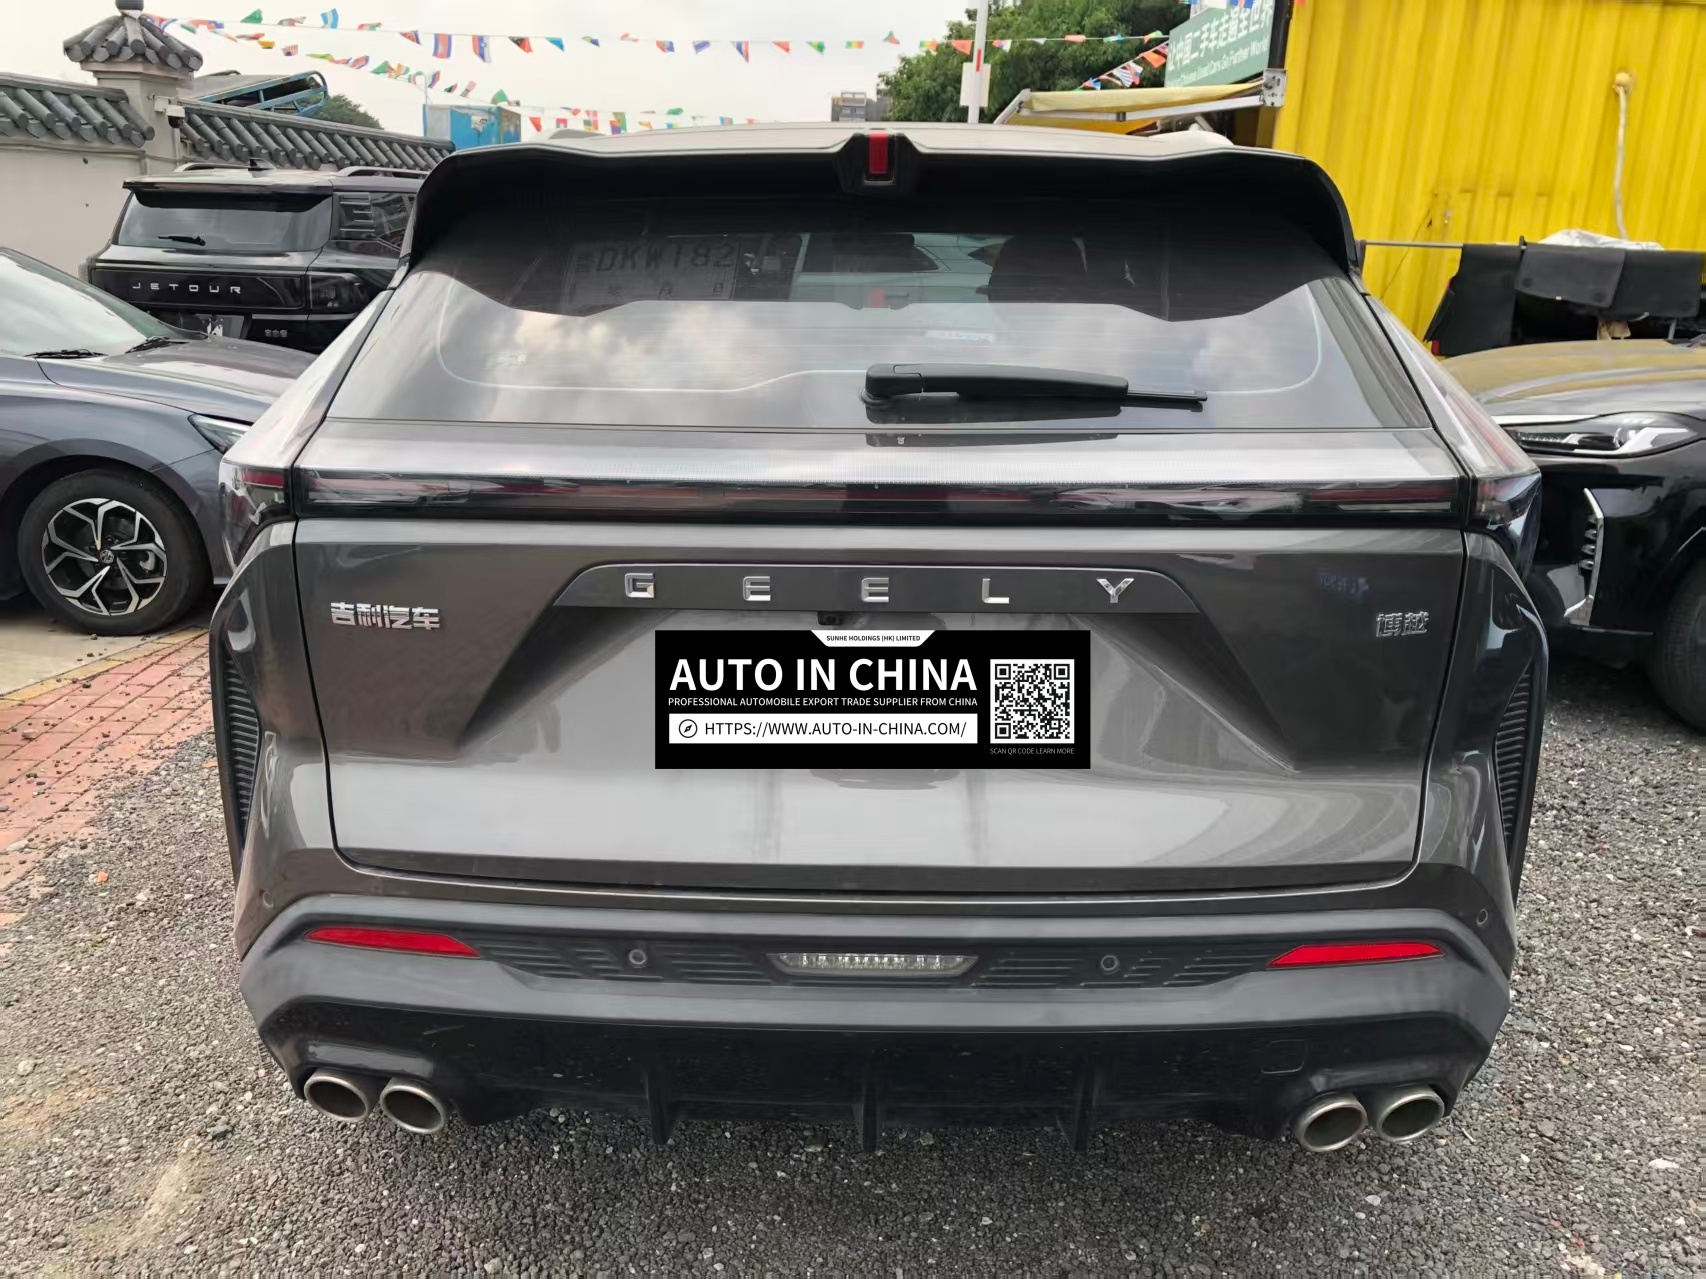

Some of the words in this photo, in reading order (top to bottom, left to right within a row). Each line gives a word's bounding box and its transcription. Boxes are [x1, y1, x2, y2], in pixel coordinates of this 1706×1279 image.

[132, 282, 241, 294] JETOUR
[625, 572, 1134, 605] GEELY
[330, 601, 440, 630] 吉利汽车
[1376, 611, 1429, 637] 博越
